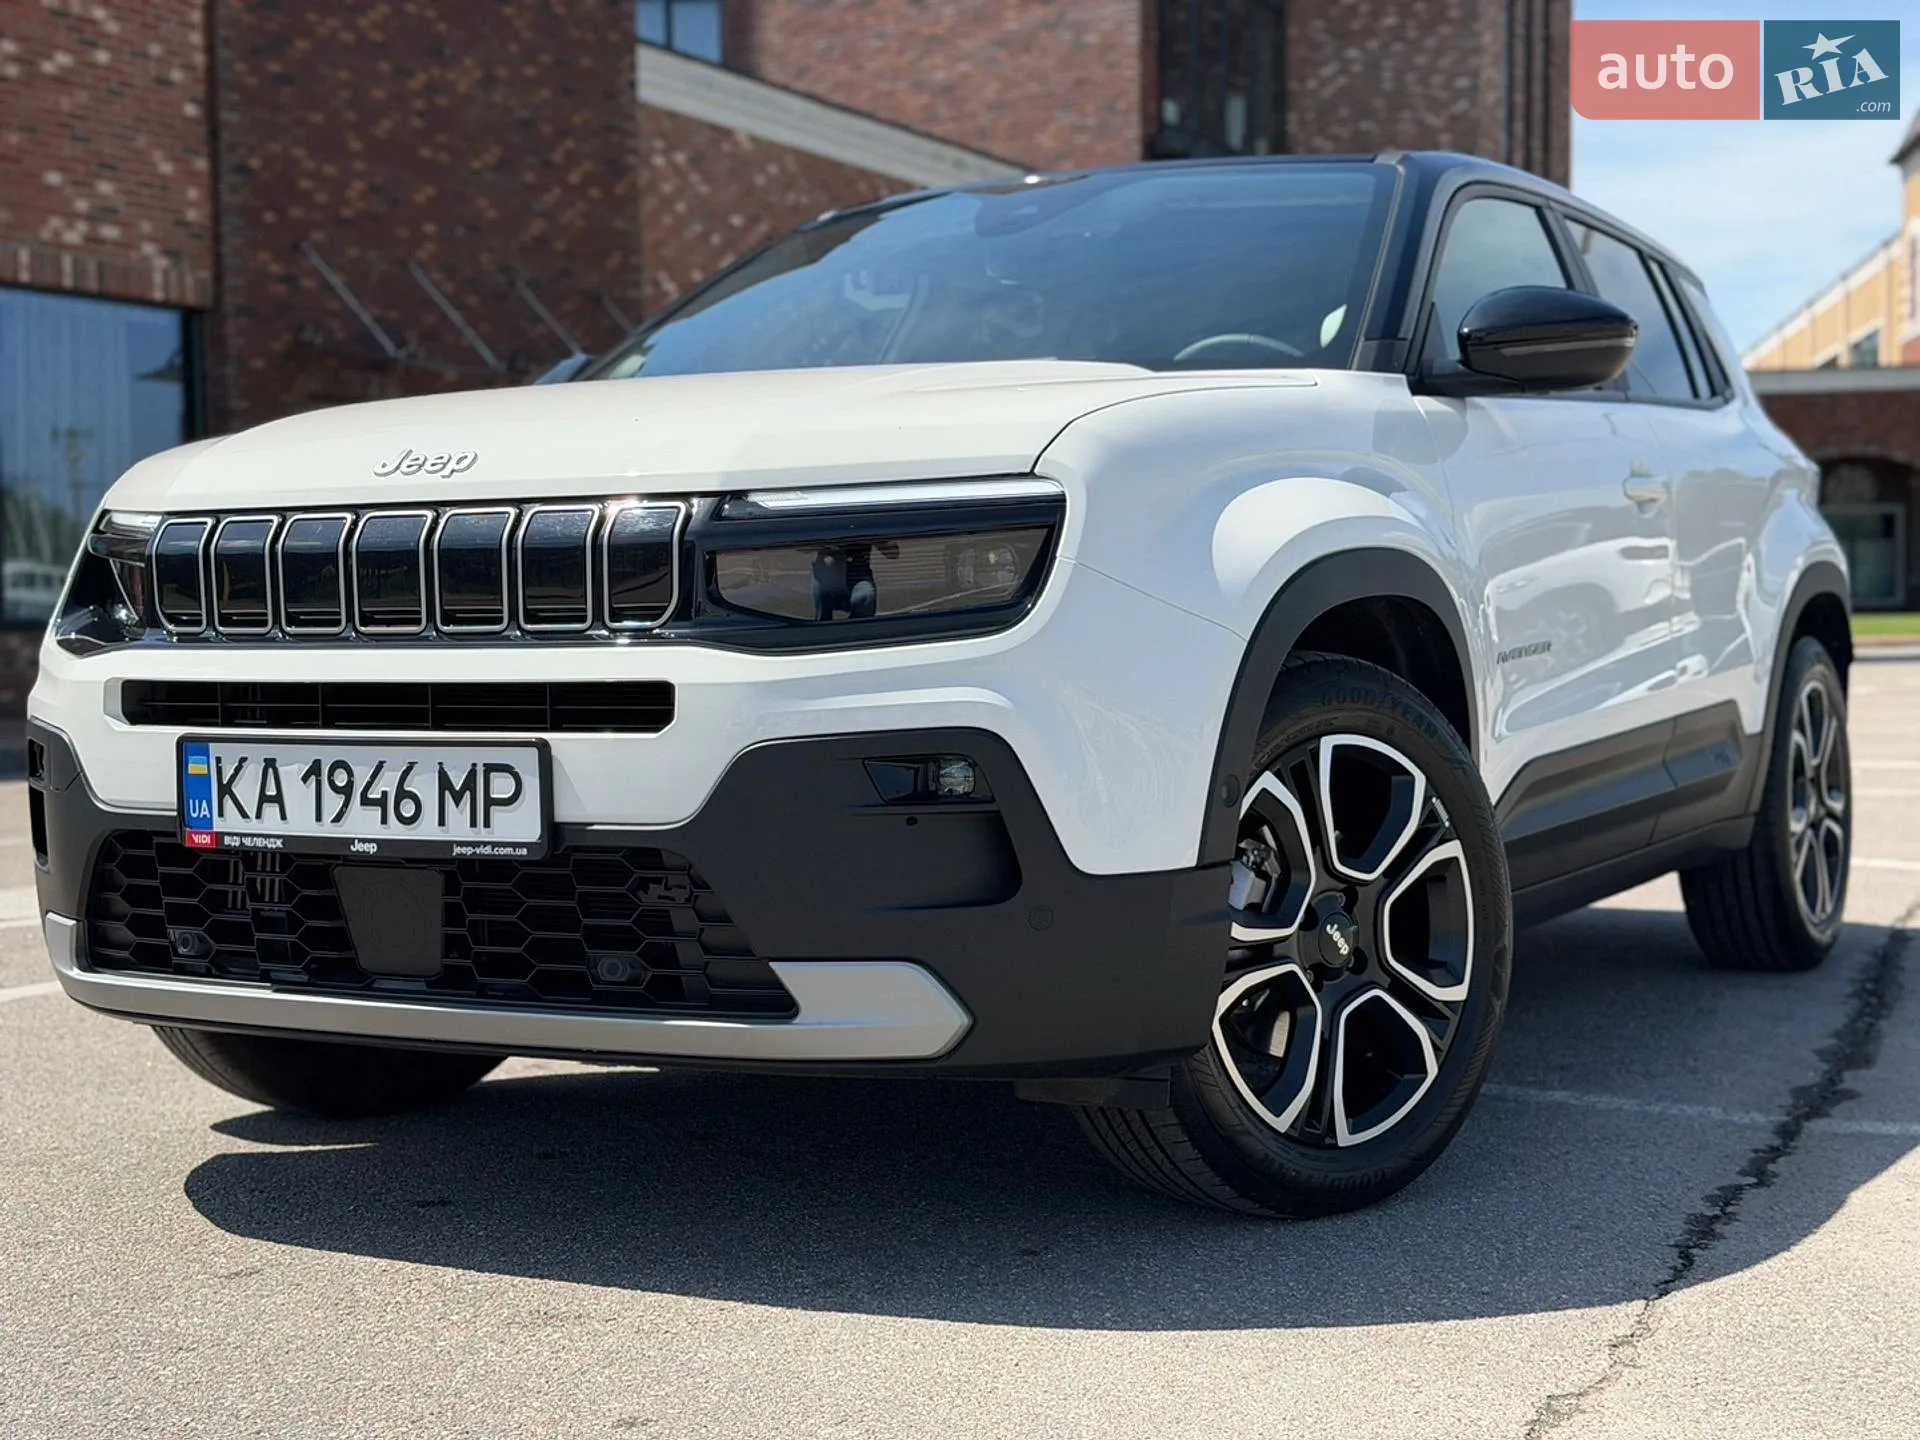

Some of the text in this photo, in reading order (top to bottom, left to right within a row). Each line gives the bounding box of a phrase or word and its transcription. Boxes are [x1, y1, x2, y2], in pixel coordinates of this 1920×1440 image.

[373, 449, 479, 479] Jeep
[214, 755, 523, 829] KA 1946 MP
[189, 799, 211, 819] UA
[191, 833, 211, 844] VIDI
[350, 839, 378, 854] Jeep
[452, 843, 528, 856] jeep-vidi.com.ua
[1326, 923, 1349, 955] Jeep
